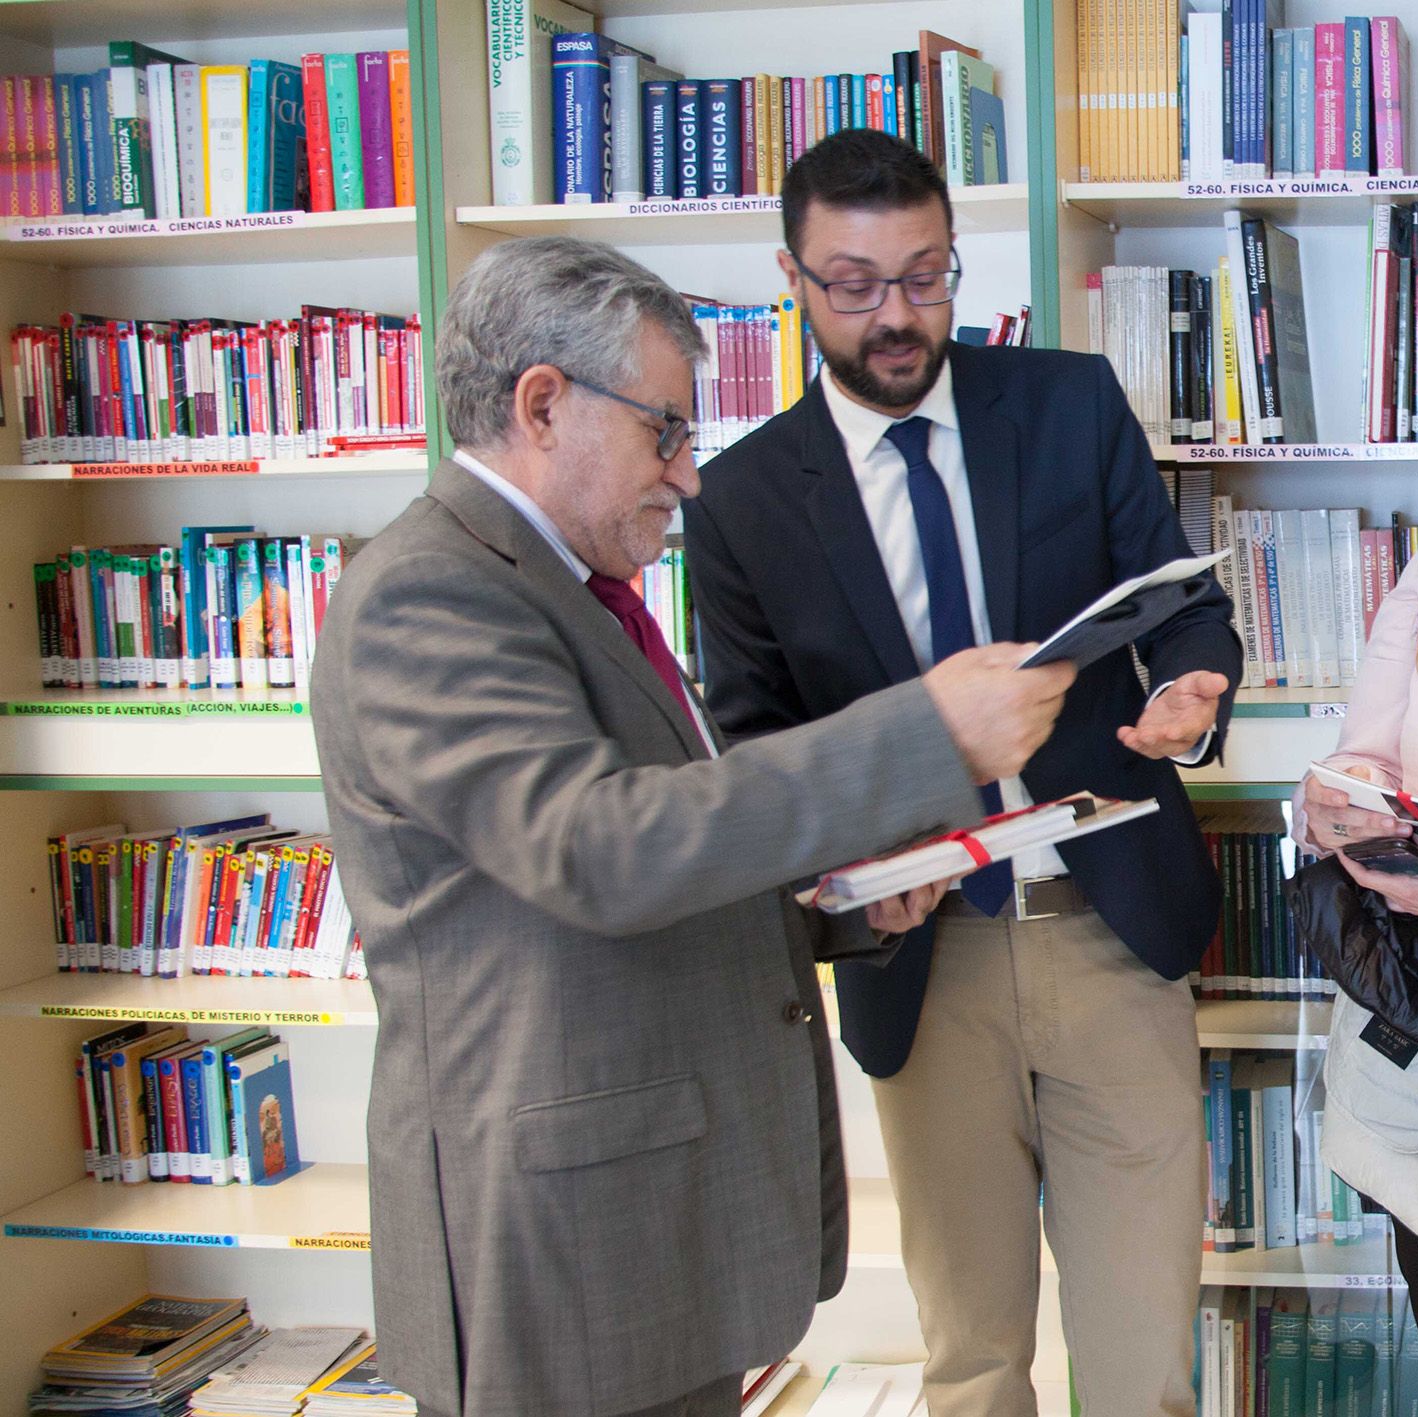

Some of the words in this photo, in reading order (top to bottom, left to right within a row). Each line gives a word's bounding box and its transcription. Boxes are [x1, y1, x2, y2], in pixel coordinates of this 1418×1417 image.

[556, 41, 593, 52] ESPASA
[1352, 30, 1361, 65] General
[1379, 20, 1388, 58] General
[1325, 60, 1334, 86] FISICA
[1352, 66, 1361, 88] Física
[1382, 60, 1392, 98] Química
[62, 85, 70, 118] General
[82, 88, 90, 120] General
[565, 72, 574, 129] NATURALEZA
[652, 104, 664, 132] TIERRA
[566, 132, 574, 142] LA
[653, 134, 664, 144] LA
[680, 103, 697, 197] BIOLOGÍA
[713, 102, 726, 193] CIENCIAS
[1352, 131, 1361, 158] 1000
[566, 145, 575, 157] DE
[654, 146, 664, 156] DE
[1384, 141, 1394, 168] 1000
[119, 127, 134, 204] BIOQUÍMICA
[566, 160, 576, 193] ONARIO
[654, 158, 664, 195] CIENCIAS
[66, 178, 76, 203] 1000
[86, 180, 96, 206] 1000
[1188, 184, 1226, 196] 52-60.
[1230, 181, 1274, 194] FÍSICA
[1278, 183, 1286, 193] Y
[1290, 180, 1353, 194] QUÍMICA.
[630, 201, 718, 214] DICCIONARIOS
[722, 197, 783, 211] CIENTÍFIC
[1412, 212, 1418, 224] 1
[22, 228, 54, 238] 52-60.
[57, 224, 94, 236] FÍSICA
[97, 226, 105, 234] Y
[108, 222, 160, 234] QUÍMICA.
[169, 220, 222, 232] CIENCIAS
[225, 215, 294, 228] NATURALES
[1247, 236, 1258, 278] Grandes
[1256, 242, 1268, 284] Inventos
[1249, 278, 1259, 294] Los
[1264, 386, 1276, 416] OUSSE
[1190, 448, 1228, 458] 52-60.
[1232, 446, 1276, 458] FÍSICA
[1280, 448, 1288, 457] Y
[1292, 445, 1354, 458] QUÍMICA.
[74, 465, 154, 476] NARRACIONES
[157, 465, 172, 475] DE
[174, 464, 189, 474] LA
[191, 464, 219, 474] VIDA
[222, 462, 251, 473] REAL
[1238, 538, 1249, 574] SELECTIVIDAD
[1266, 551, 1274, 560] ESO
[1364, 545, 1374, 612] MATEMÁTICAS
[1258, 588, 1269, 625] MATEMÁTICAS
[1269, 588, 1279, 625] MATEMÁTICAS
[1247, 634, 1258, 662] EXAMENES
[1263, 634, 1273, 662] OBLEMAS
[1274, 634, 1283, 662] OBLEMAS
[14, 705, 94, 715] NARRACIONES
[97, 706, 112, 714] DE
[114, 705, 182, 716] AVENTURAS
[186, 702, 237, 714] (ACCIÓN,
[240, 702, 294, 714] VIAJES...)
[42, 1006, 118, 1018] NARRACIONES
[121, 1010, 190, 1022] POLICIACAS,
[192, 1011, 206, 1020] DE
[208, 1012, 262, 1022] MISTERIO
[264, 1012, 273, 1022] Y
[275, 1012, 320, 1023] TERROR
[12, 1226, 88, 1240] NARRACIONES
[1345, 1276, 1364, 1286] 33.
